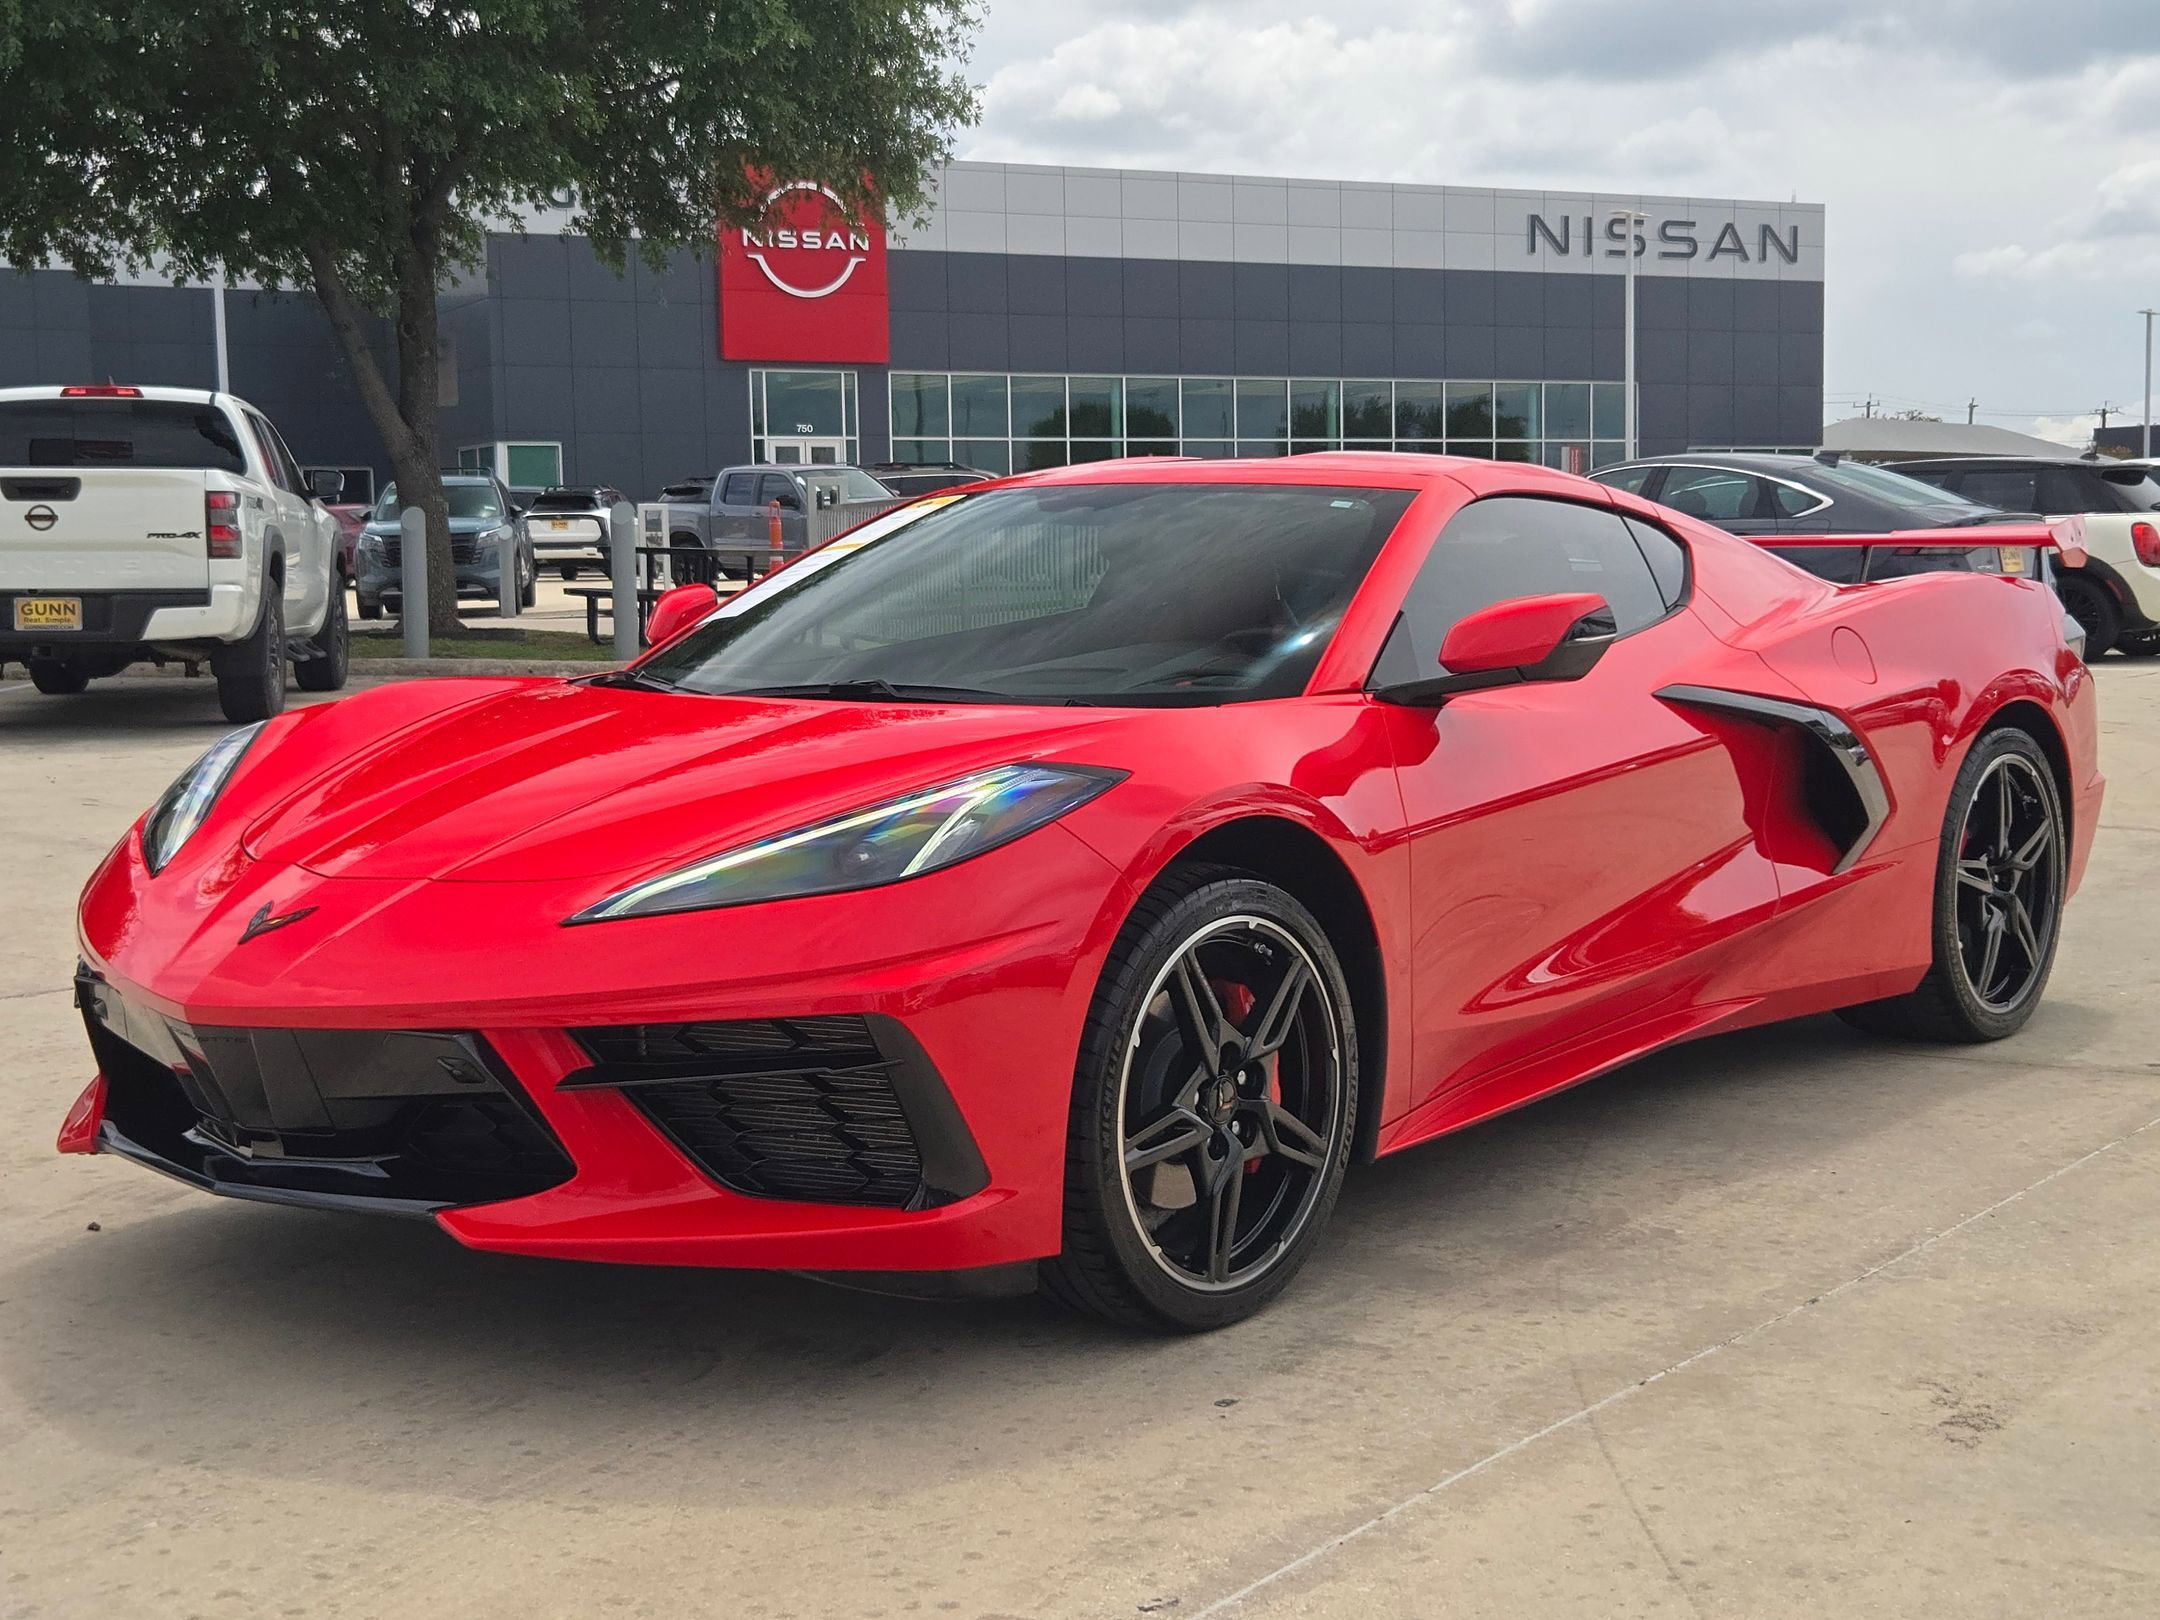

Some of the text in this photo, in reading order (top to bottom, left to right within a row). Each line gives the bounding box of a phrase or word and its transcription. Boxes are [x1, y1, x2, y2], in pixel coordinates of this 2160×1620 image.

[1527, 213, 1799, 264] NISSAN
[796, 424, 814, 433] 750
[20, 603, 76, 616] GUNN
[1101, 1033, 1123, 1149] MICHELIN
